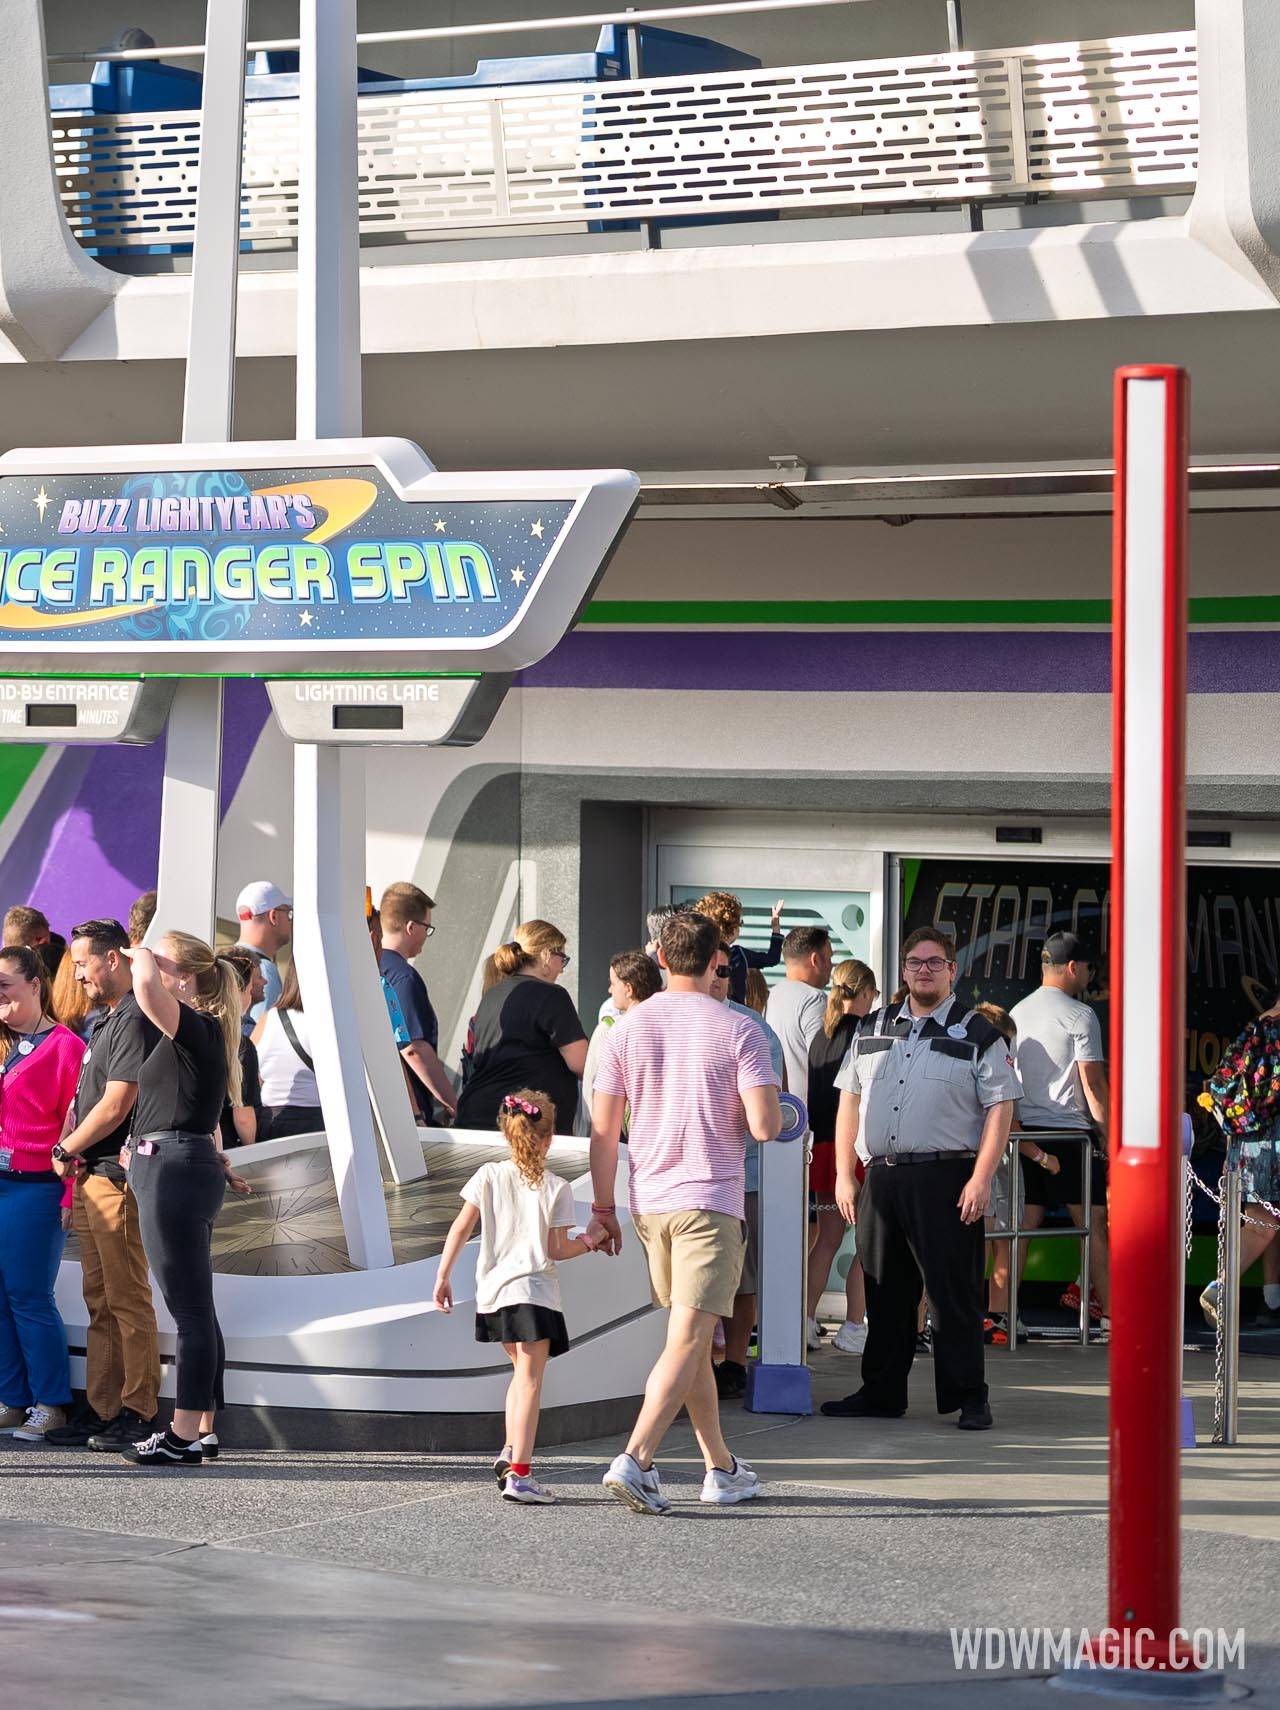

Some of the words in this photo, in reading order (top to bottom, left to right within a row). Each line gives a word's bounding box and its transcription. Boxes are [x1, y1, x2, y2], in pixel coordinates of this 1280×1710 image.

[57, 498, 131, 535] BUZZ
[135, 493, 318, 533] LIGHTYEAR'S
[89, 543, 339, 606] RANGER
[346, 541, 501, 604] SPIN
[45, 684, 129, 701] ENTRANCE
[295, 684, 388, 702] LIGHTNING
[392, 684, 440, 702] LANE
[2, 709, 23, 725] TIME
[77, 709, 119, 725] MINUTES
[933, 881, 1053, 980] STAR
